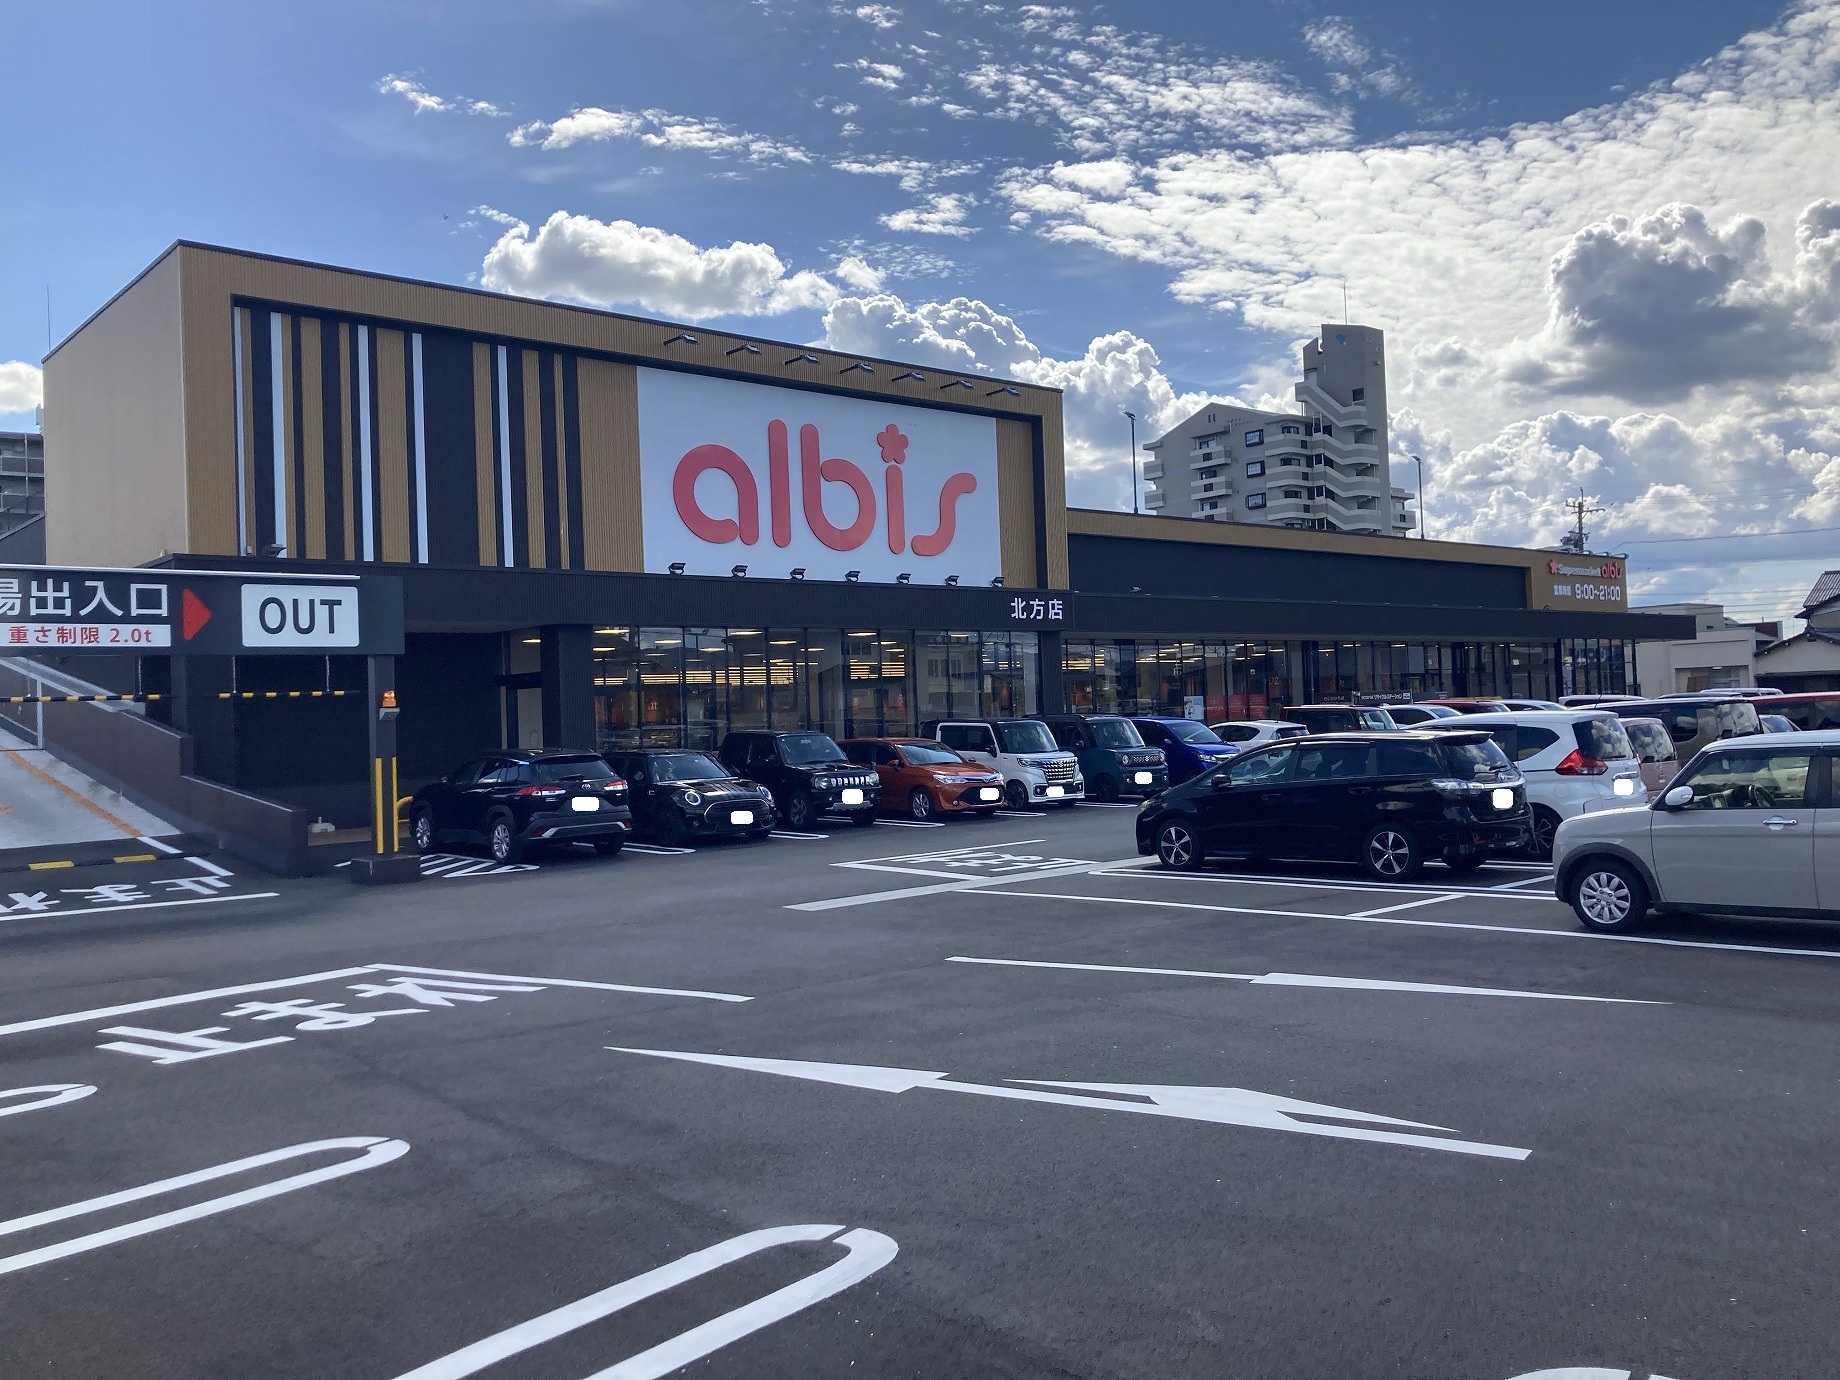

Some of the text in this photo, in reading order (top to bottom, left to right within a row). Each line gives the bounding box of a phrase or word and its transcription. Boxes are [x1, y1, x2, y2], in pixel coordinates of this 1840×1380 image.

[673, 419, 977, 556] albis
[258, 597, 343, 635] OUT
[1010, 597, 1063, 621] 北方店
[9, 626, 152, 644] 重さ制限 2.0t
[95, 977, 547, 1064] 止まれ
